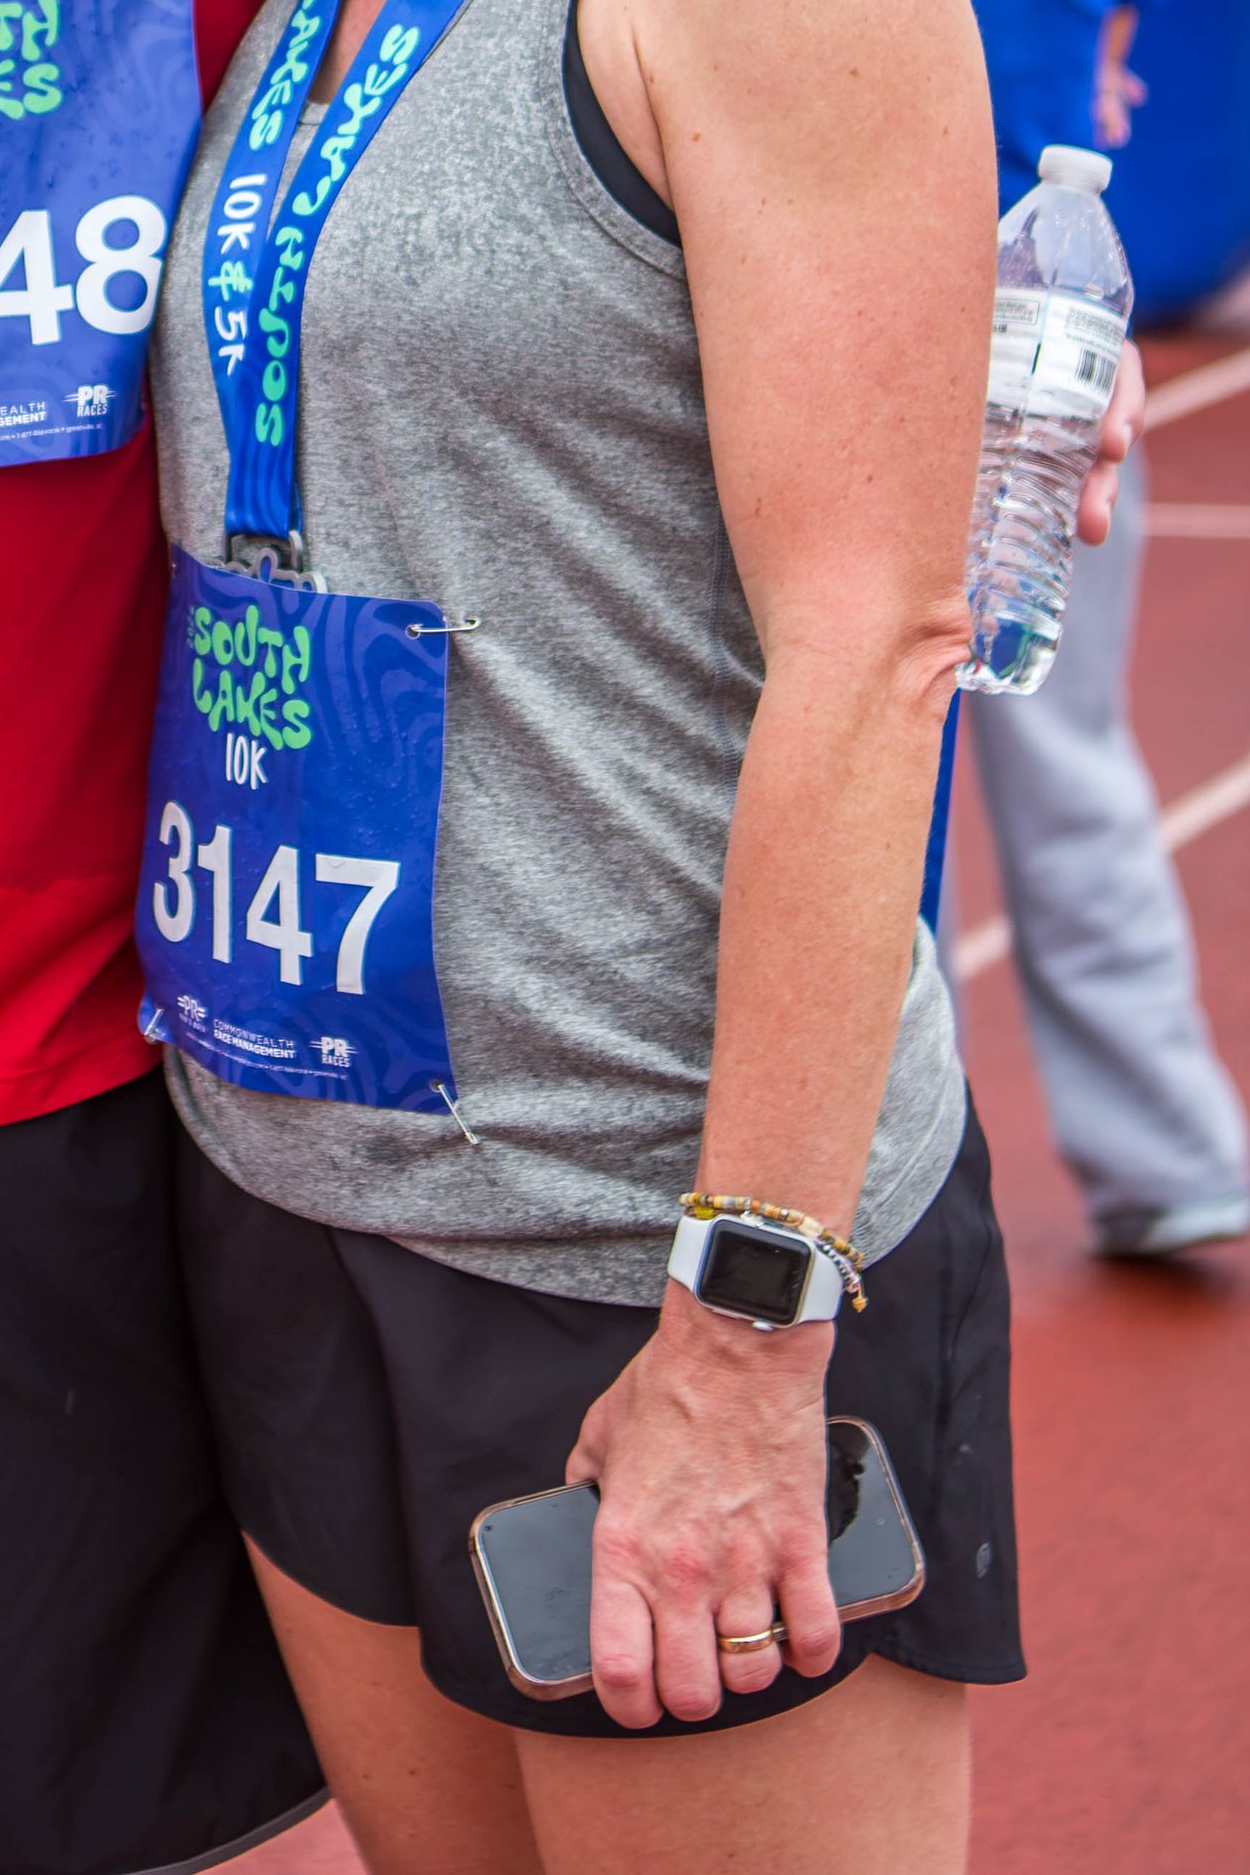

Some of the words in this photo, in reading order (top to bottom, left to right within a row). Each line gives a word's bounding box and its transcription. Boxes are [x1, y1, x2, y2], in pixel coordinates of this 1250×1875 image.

[217, 173, 268, 255] 10K
[255, 226, 305, 446] SOUTH
[292, 24, 419, 216] LAKES
[76, 385, 109, 406] PR
[76, 404, 108, 418] RACES
[193, 604, 311, 695] SOUTH
[192, 658, 312, 751] LAKES
[225, 732, 268, 791] 10K
[153, 800, 400, 995] 3147
[320, 1036, 349, 1058] PR
[321, 1053, 350, 1068] RACES
